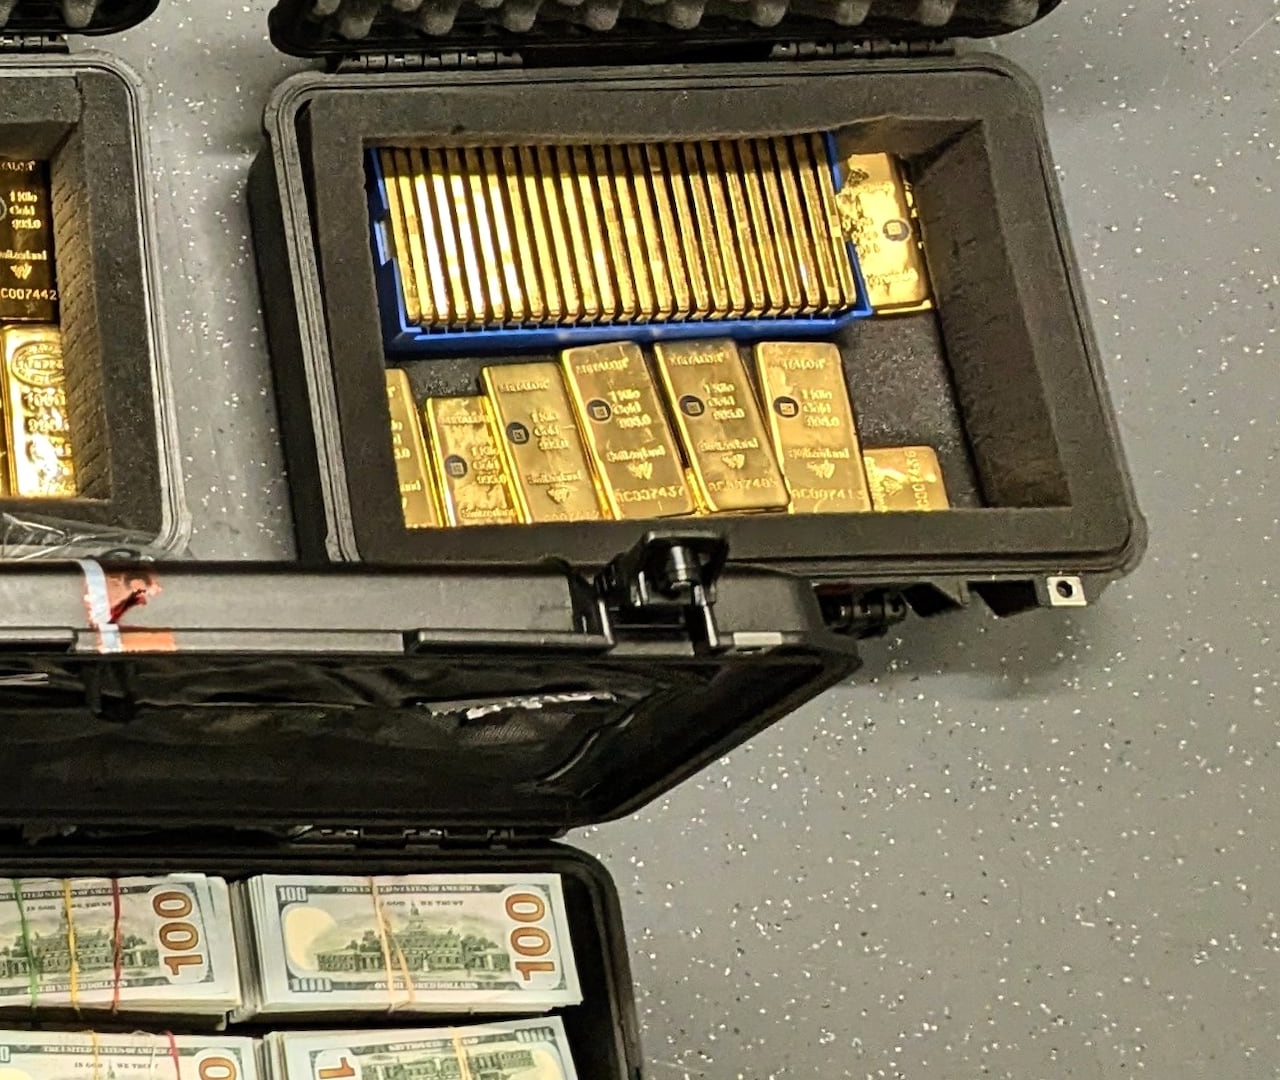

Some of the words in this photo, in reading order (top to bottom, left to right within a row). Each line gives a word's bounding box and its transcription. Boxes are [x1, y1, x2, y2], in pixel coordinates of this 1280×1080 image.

[17, 191, 37, 202] Kilo
[278, 887, 307, 902] 100
[152, 891, 203, 976] 100
[505, 893, 554, 981] 100
